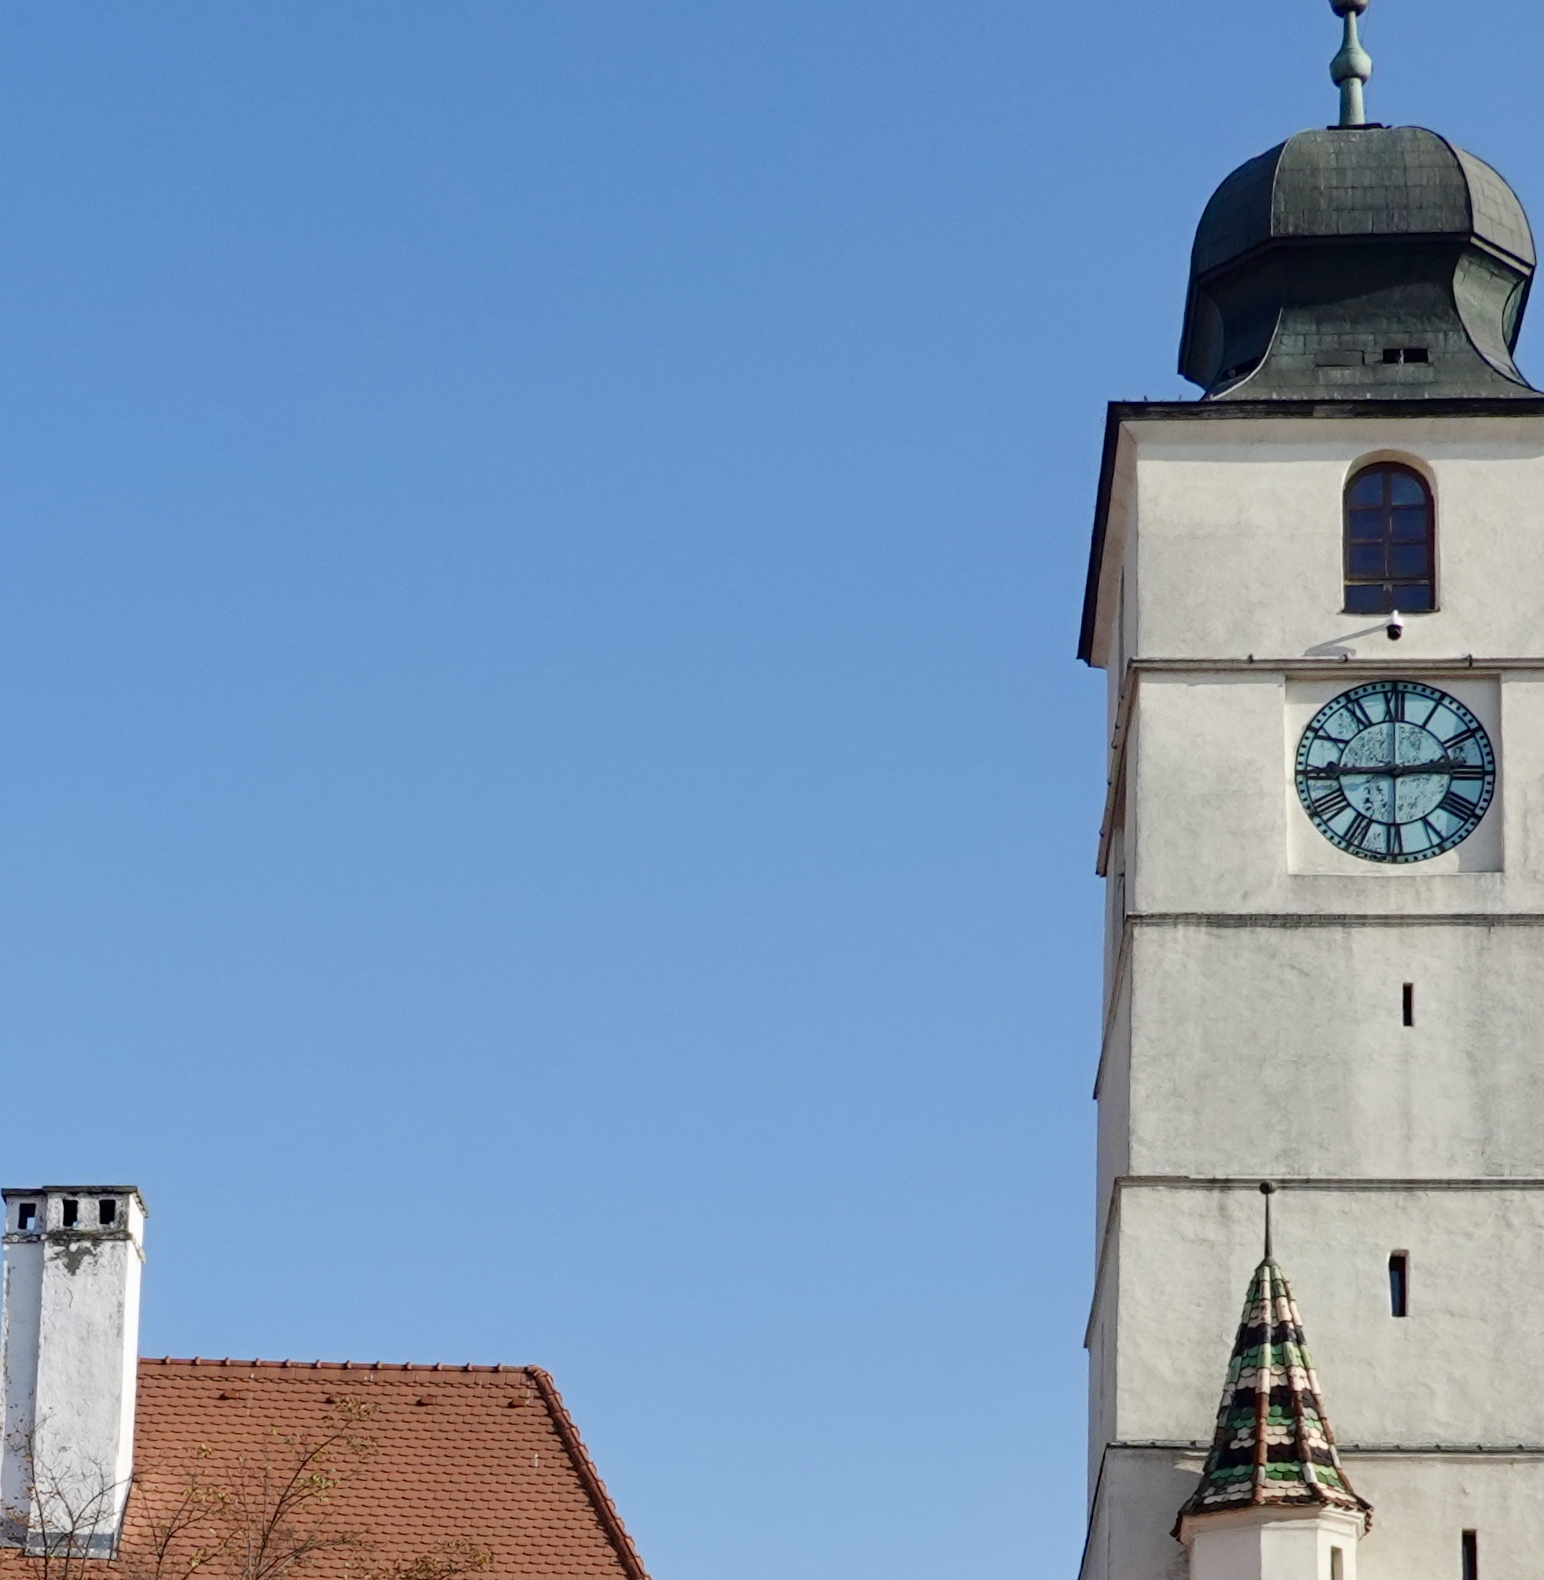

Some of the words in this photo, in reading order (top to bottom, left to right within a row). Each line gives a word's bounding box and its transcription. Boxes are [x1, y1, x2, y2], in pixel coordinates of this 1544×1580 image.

[1344, 699, 1374, 731] XI
[1383, 691, 1406, 722] XII
[1314, 727, 1350, 752] X
[1443, 729, 1475, 749] II
[1313, 788, 1350, 823] VIII
[1343, 814, 1373, 848] VII
[1386, 825, 1404, 855] VI
[1422, 819, 1448, 847] V
